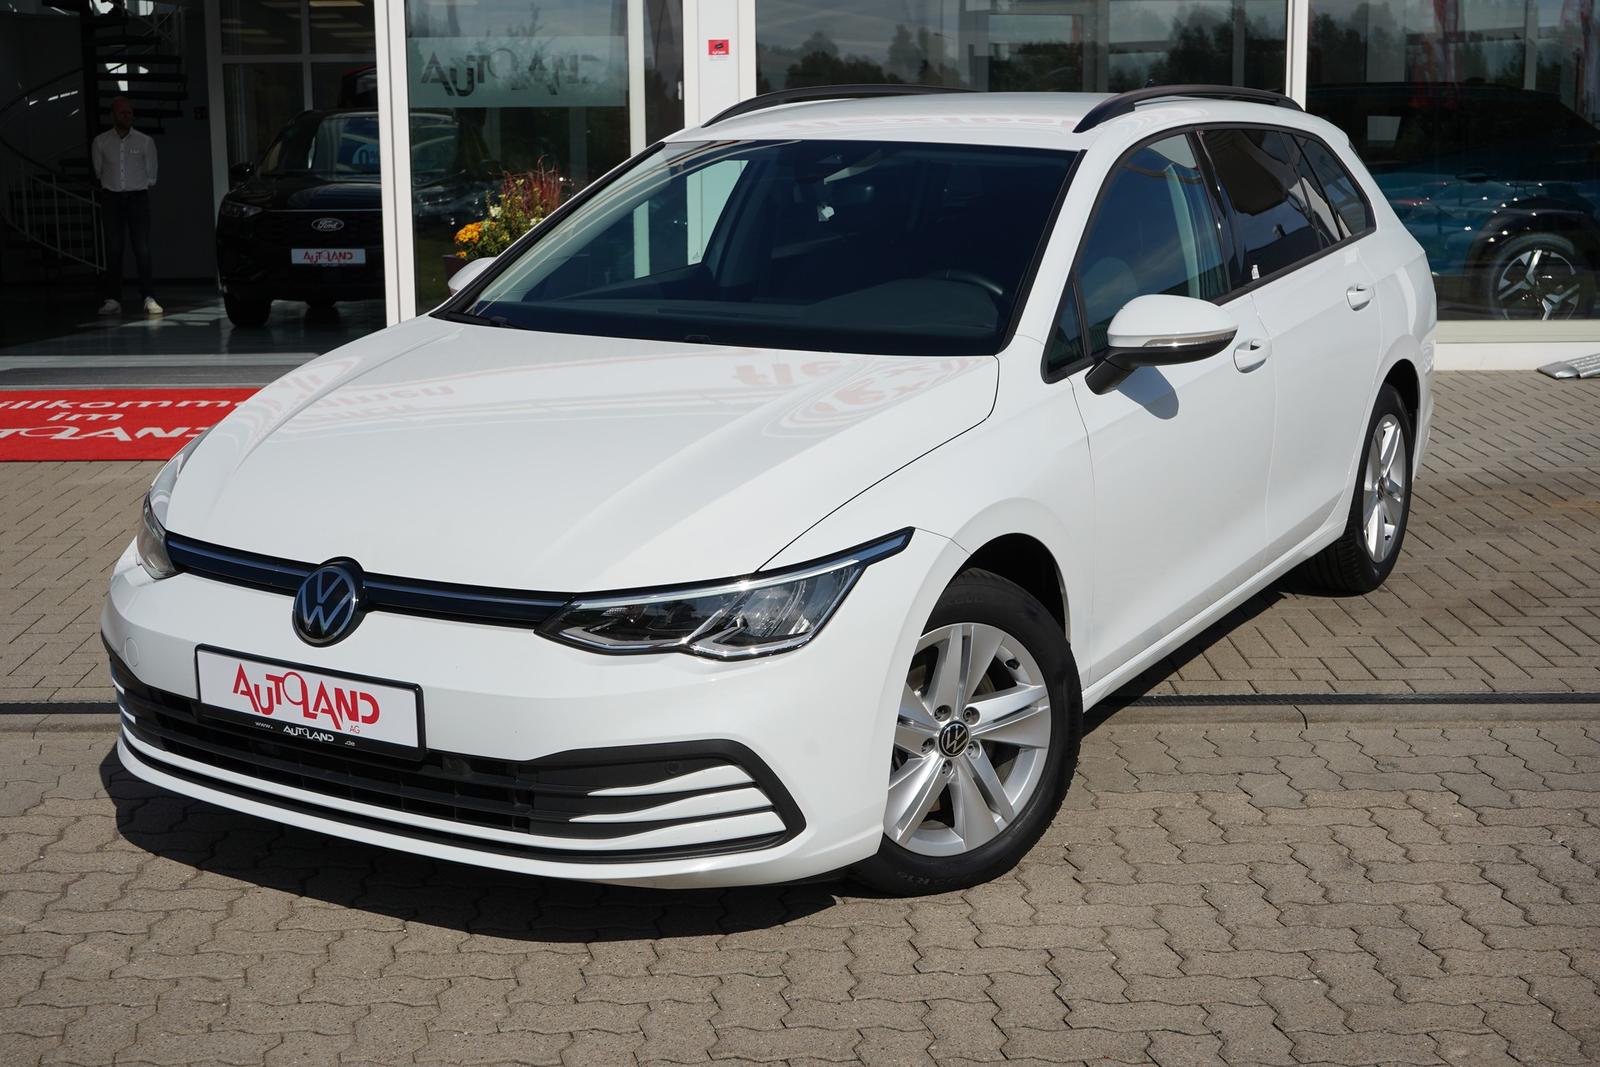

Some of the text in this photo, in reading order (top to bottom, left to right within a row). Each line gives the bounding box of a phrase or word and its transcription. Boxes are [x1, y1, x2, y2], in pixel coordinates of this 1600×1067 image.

[304, 251, 353, 263] AUTOLAND
[47, 411, 124, 421] im
[233, 663, 380, 730] AUTOLAND
[283, 725, 334, 742] AUTOLAND
[349, 724, 360, 734] AG
